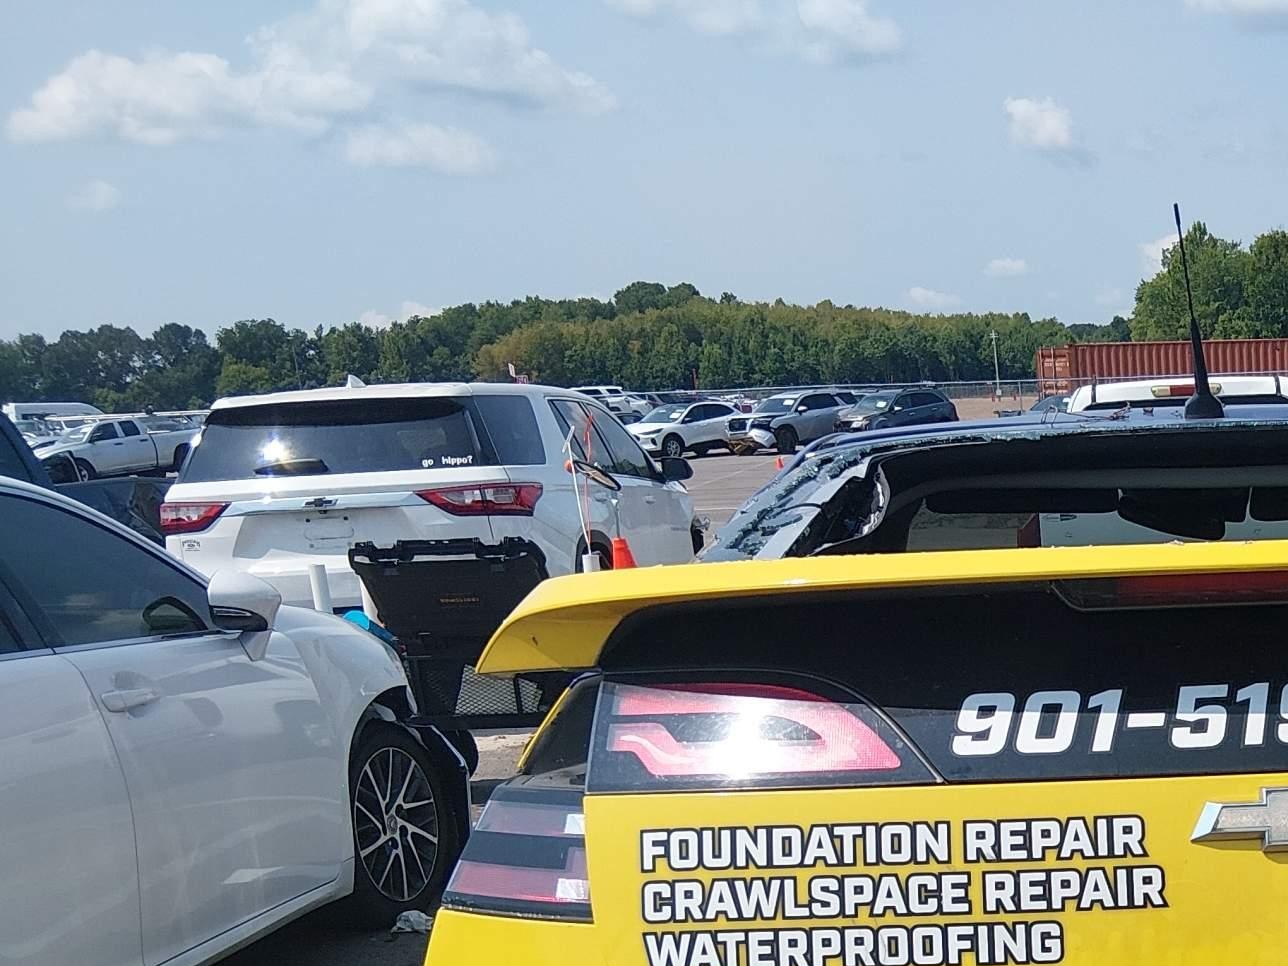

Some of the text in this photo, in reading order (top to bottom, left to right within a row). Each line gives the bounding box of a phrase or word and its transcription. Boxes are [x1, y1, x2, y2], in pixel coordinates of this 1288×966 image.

[640, 815, 1147, 873] FOUNDATION REPAIR
[642, 865, 1168, 924] CRAWLSPACE REPAIR
